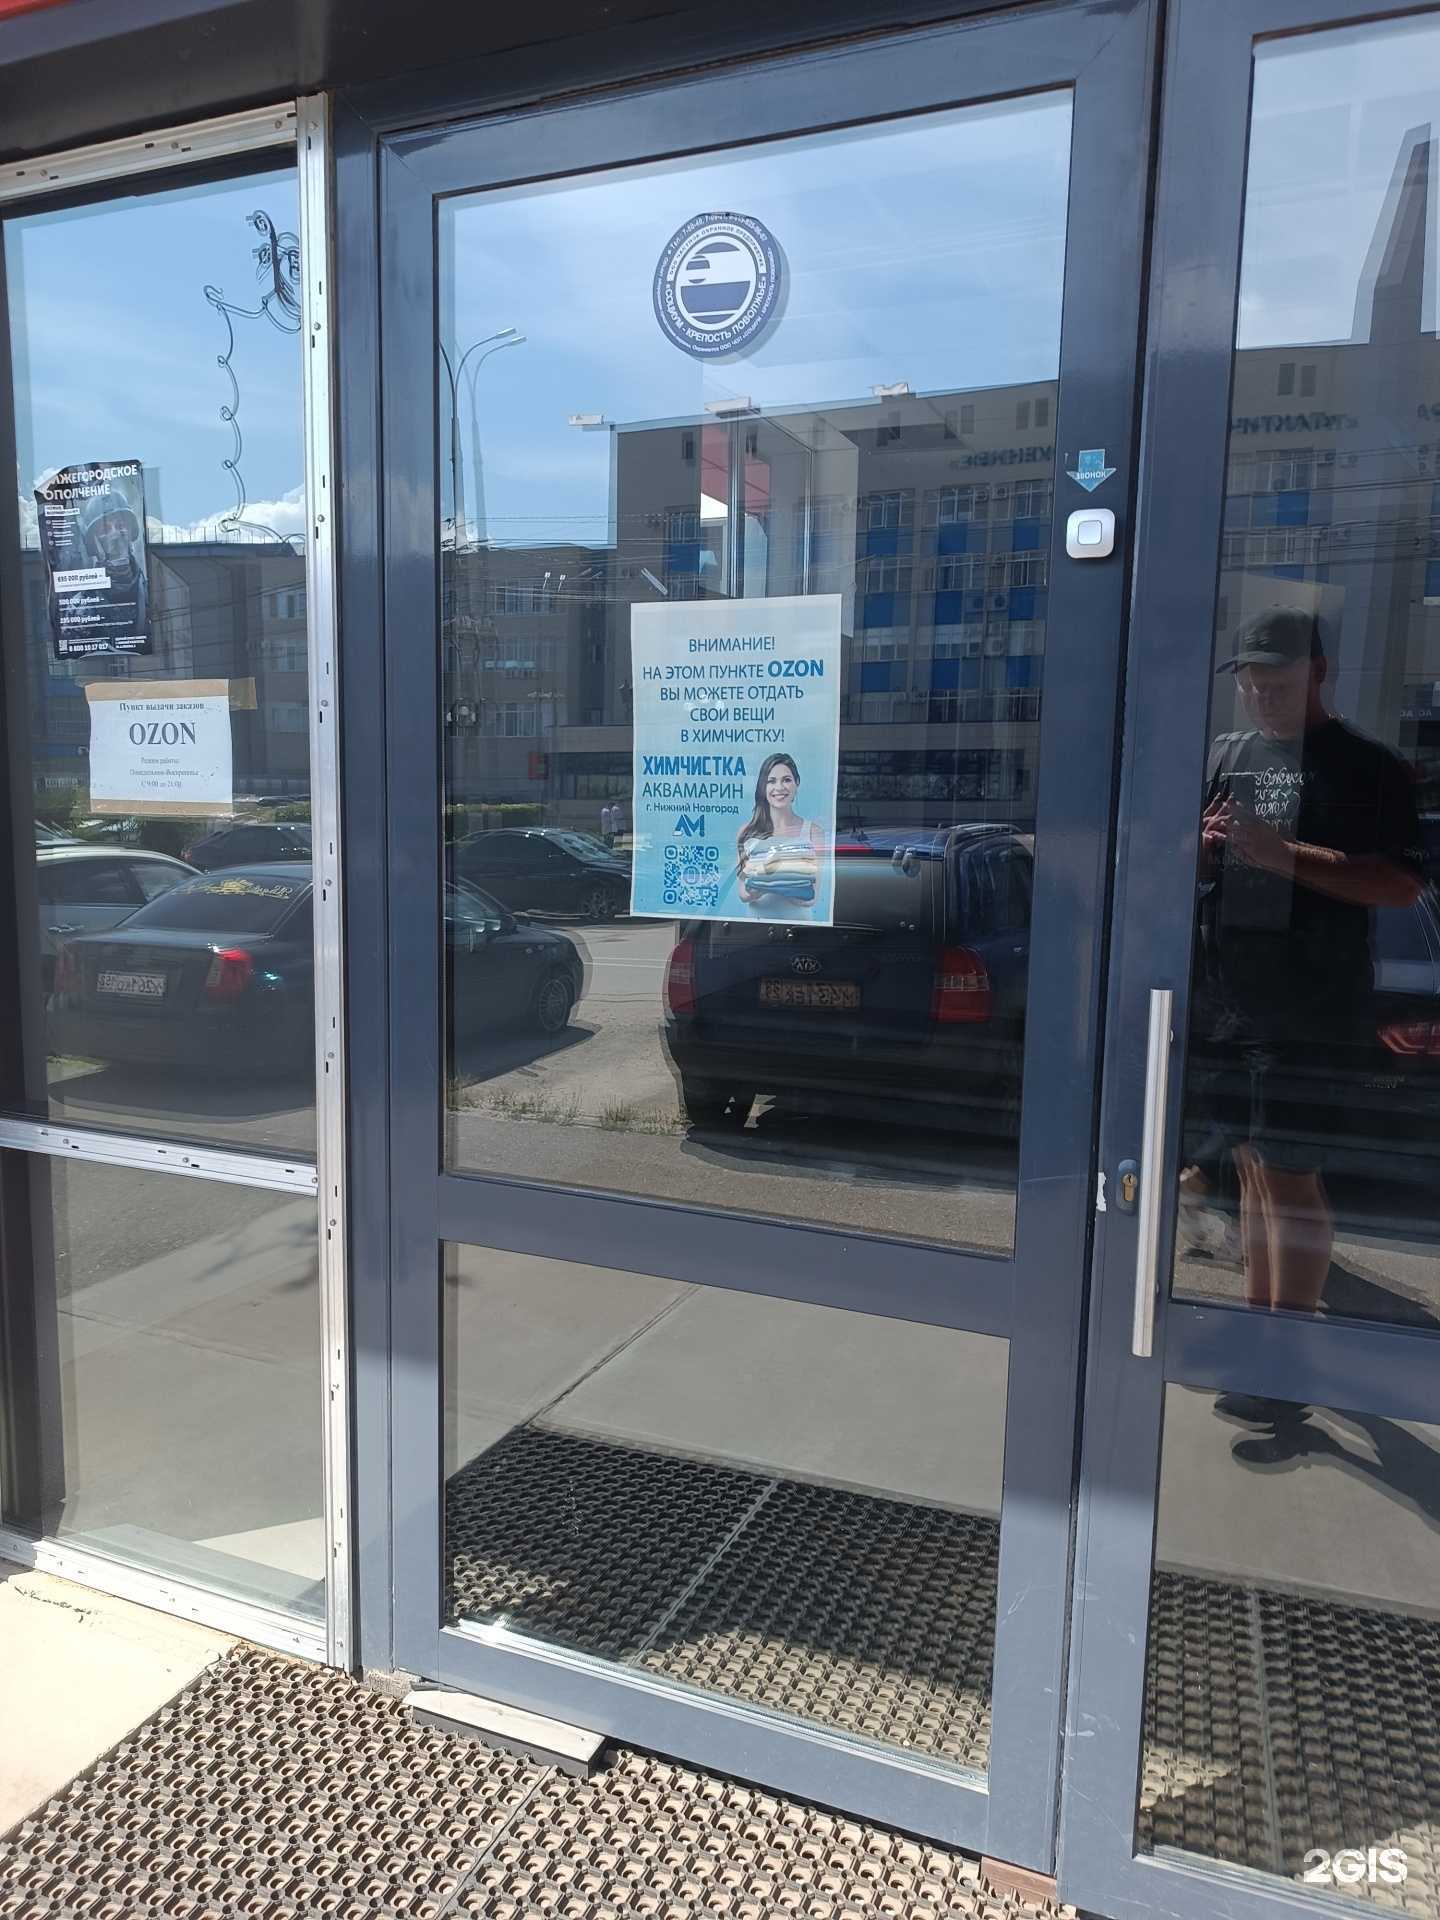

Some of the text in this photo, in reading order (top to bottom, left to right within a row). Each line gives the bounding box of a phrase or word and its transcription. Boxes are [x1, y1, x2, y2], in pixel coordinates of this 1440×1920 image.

[701, 225, 734, 236] ОХРАННОЕ
[686, 327, 732, 343] КРЕПОСТЬ
[732, 276, 767, 335] ПОВОЛЖЬЕ»
[48, 465, 138, 485] ИЖЕГОРОДСКОЕ
[43, 483, 111, 500] ОПОЛЧЕНИЕ
[689, 636, 775, 653] ВНИМАНИЕ!
[643, 659, 824, 680] НА ЭТОМ ПУНКТЕ OZON
[660, 685, 804, 701] ВЫ МОЖЕТЕ ОТДАТЬ
[120, 702, 204, 713] Пункт выдачи заказов
[690, 707, 775, 724] СВОИ ВЕЩИ
[129, 722, 196, 745] OZON
[681, 728, 785, 743] В ХИМЧИСТКУ!
[642, 755, 746, 776] ХИМЧИСТКА
[642, 782, 744, 800] АКВАМАРИН
[653, 802, 691, 814] Нижний
[692, 802, 740, 815] Новгород
